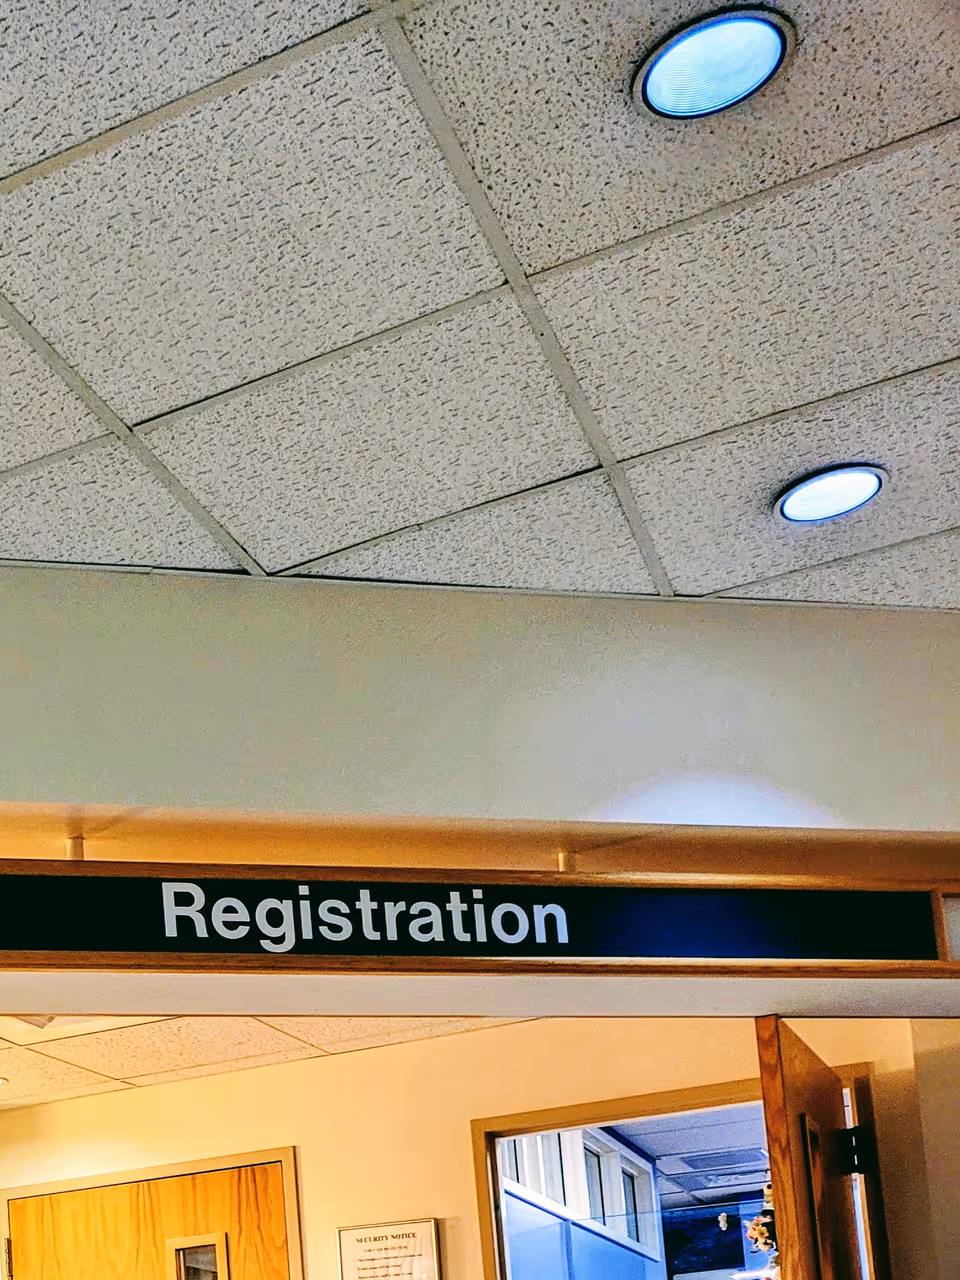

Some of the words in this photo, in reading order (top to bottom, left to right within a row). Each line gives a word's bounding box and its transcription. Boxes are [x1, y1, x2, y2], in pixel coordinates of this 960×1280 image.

[161, 882, 569, 953] Registration
[356, 1235, 388, 1243] SECURITY
[391, 1232, 417, 1240] NOTICE
